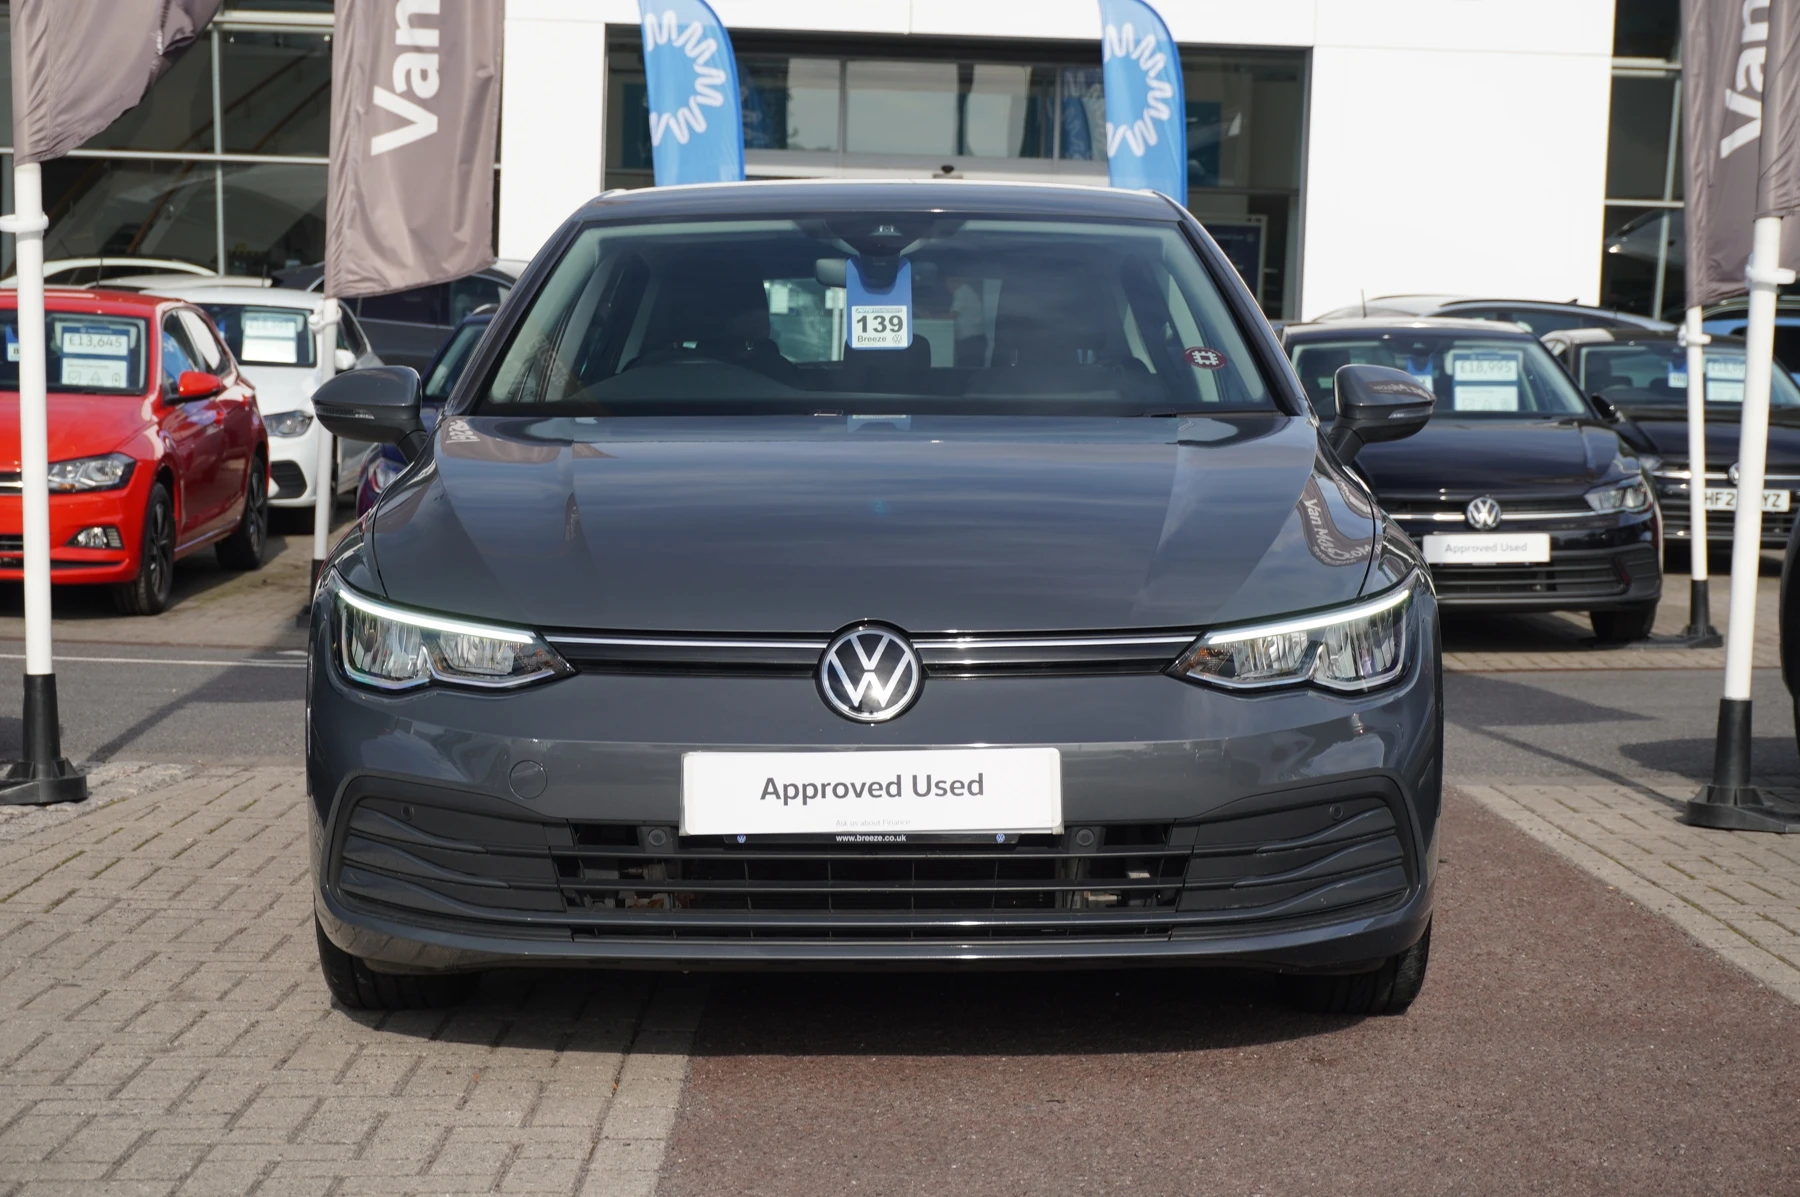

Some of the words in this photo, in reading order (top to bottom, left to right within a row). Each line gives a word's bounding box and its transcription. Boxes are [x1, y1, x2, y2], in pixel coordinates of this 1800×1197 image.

[370, 0, 441, 157] Van
[1720, 0, 1771, 160] Van
[856, 315, 904, 334] 139
[69, 334, 122, 349] £13,645
[857, 335, 887, 343] Breeze
[1705, 491, 1736, 507] HF2
[1445, 543, 1498, 554] Approved
[1501, 542, 1528, 552] Used
[760, 774, 902, 806] Approved
[912, 772, 984, 798] Used
[836, 819, 848, 827] Ask
[860, 819, 881, 827] about
[882, 818, 910, 826] Finance
[836, 834, 907, 842] www.breeze.co.uk
